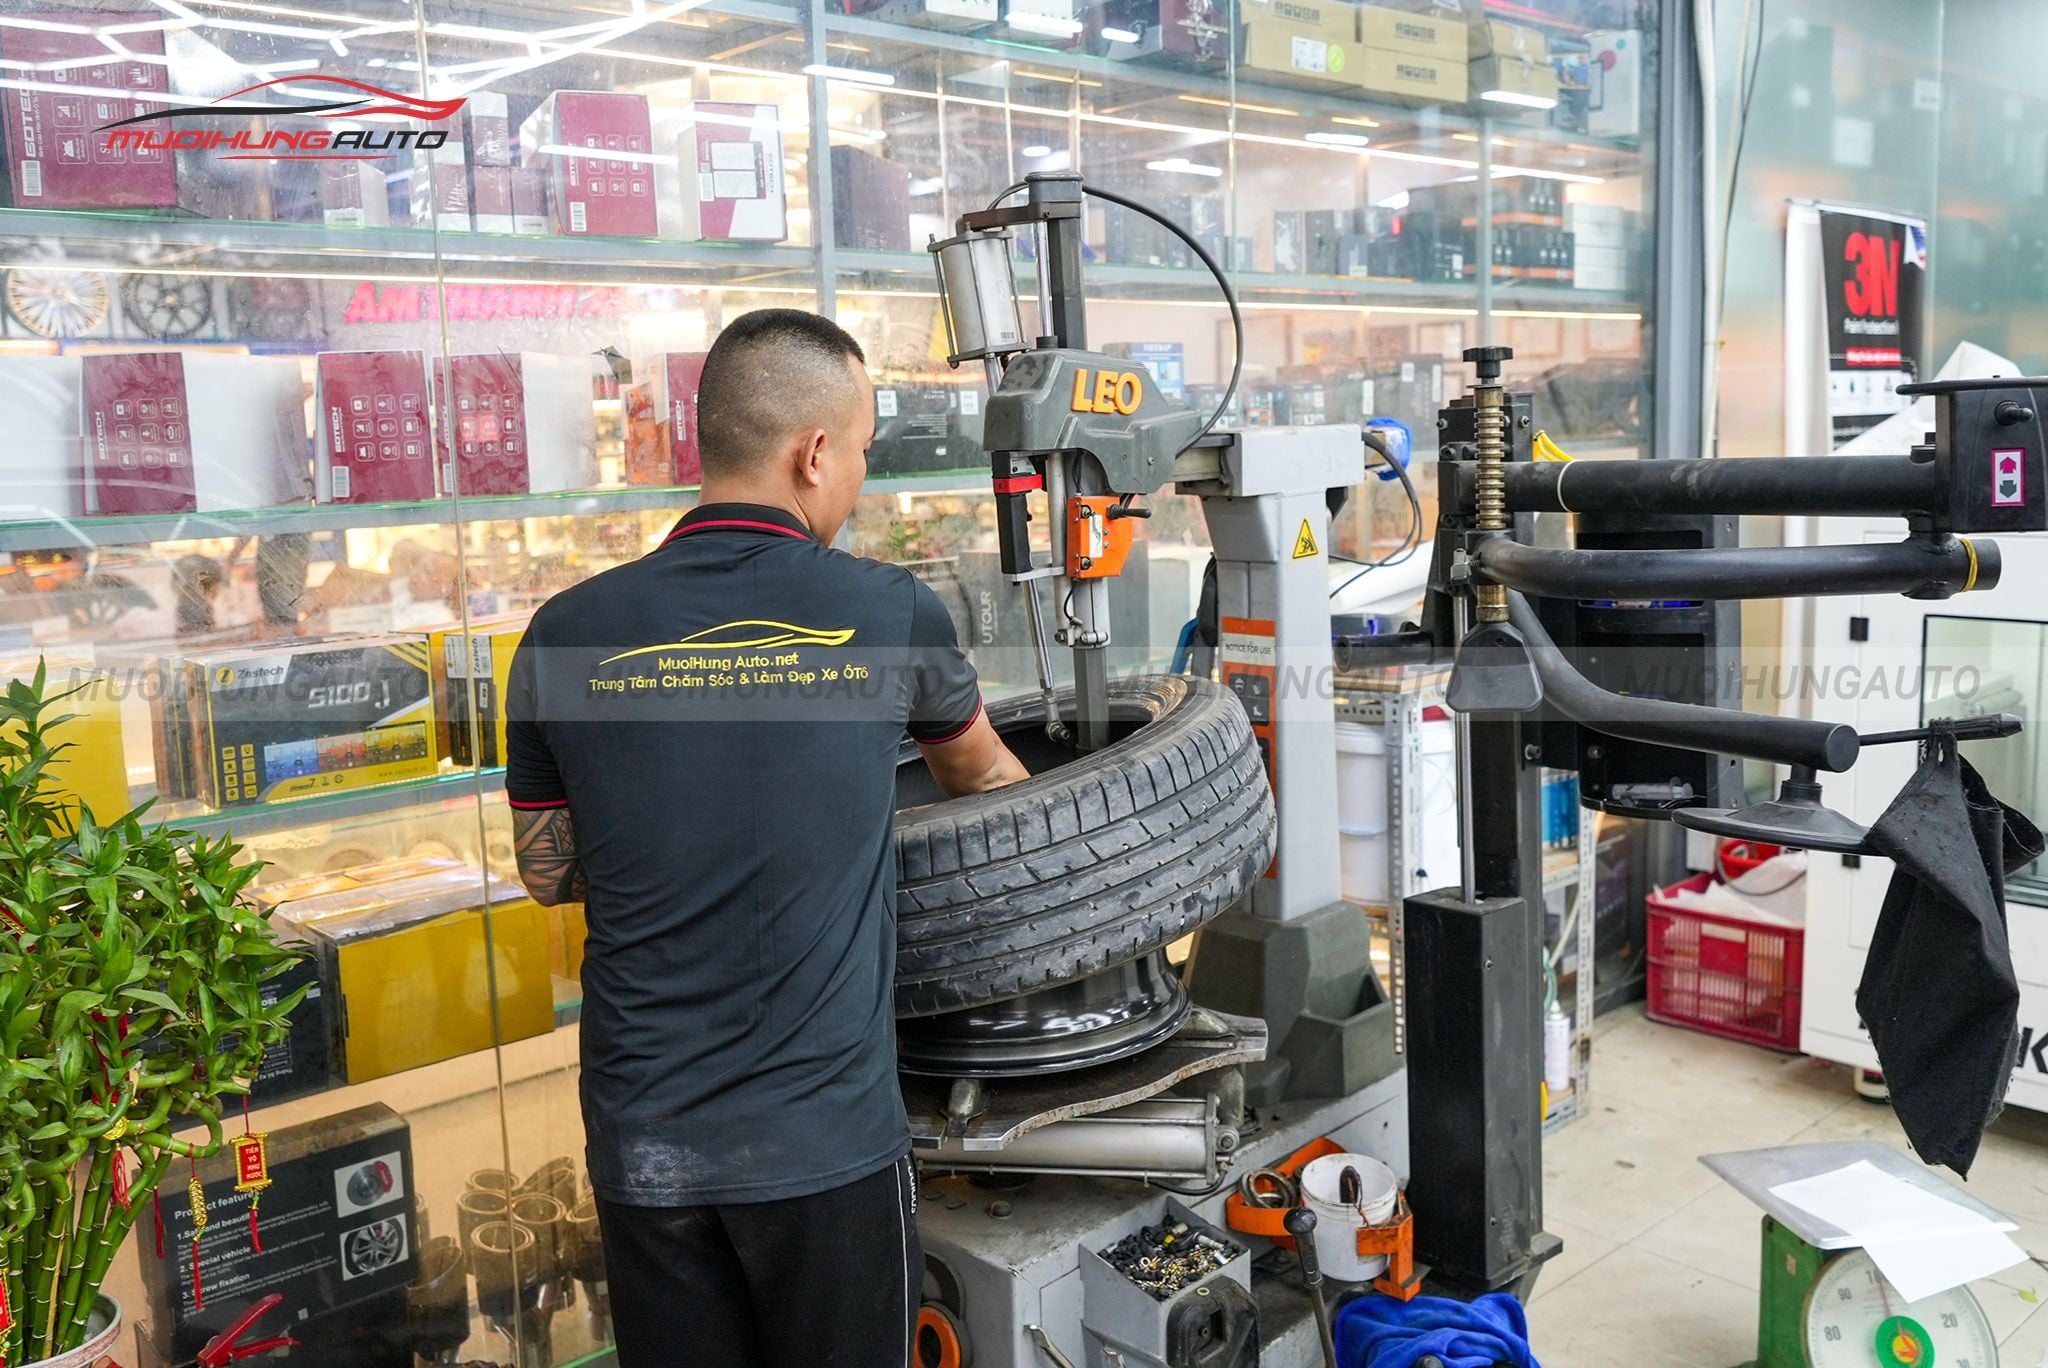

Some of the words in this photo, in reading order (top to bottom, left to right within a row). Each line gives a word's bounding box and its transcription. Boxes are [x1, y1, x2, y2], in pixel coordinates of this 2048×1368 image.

[1071, 368, 1143, 416] LEO
[980, 590, 993, 644] UTOUR
[1225, 643, 1246, 653] NOTICE
[1247, 644, 1259, 653] FOR
[1260, 646, 1272, 655] USE
[658, 656, 732, 671] MuoiHung
[238, 665, 284, 679] Zestech
[589, 678, 625, 692] Trung
[627, 675, 657, 689] Tâm
[662, 674, 704, 688] Chăm
[708, 673, 734, 687] Sóc
[739, 672, 750, 685] &
[753, 670, 783, 684] Làm
[787, 670, 816, 685] Đẹp
[821, 667, 838, 681] Xe
[174, 1201, 216, 1219] Proct
[221, 1246, 251, 1260] vehicle
[218, 1273, 250, 1289] fixation
[1838, 1287, 1852, 1300] 90
[1941, 1313, 1958, 1328] 20
[1824, 1325, 1841, 1341] 80
